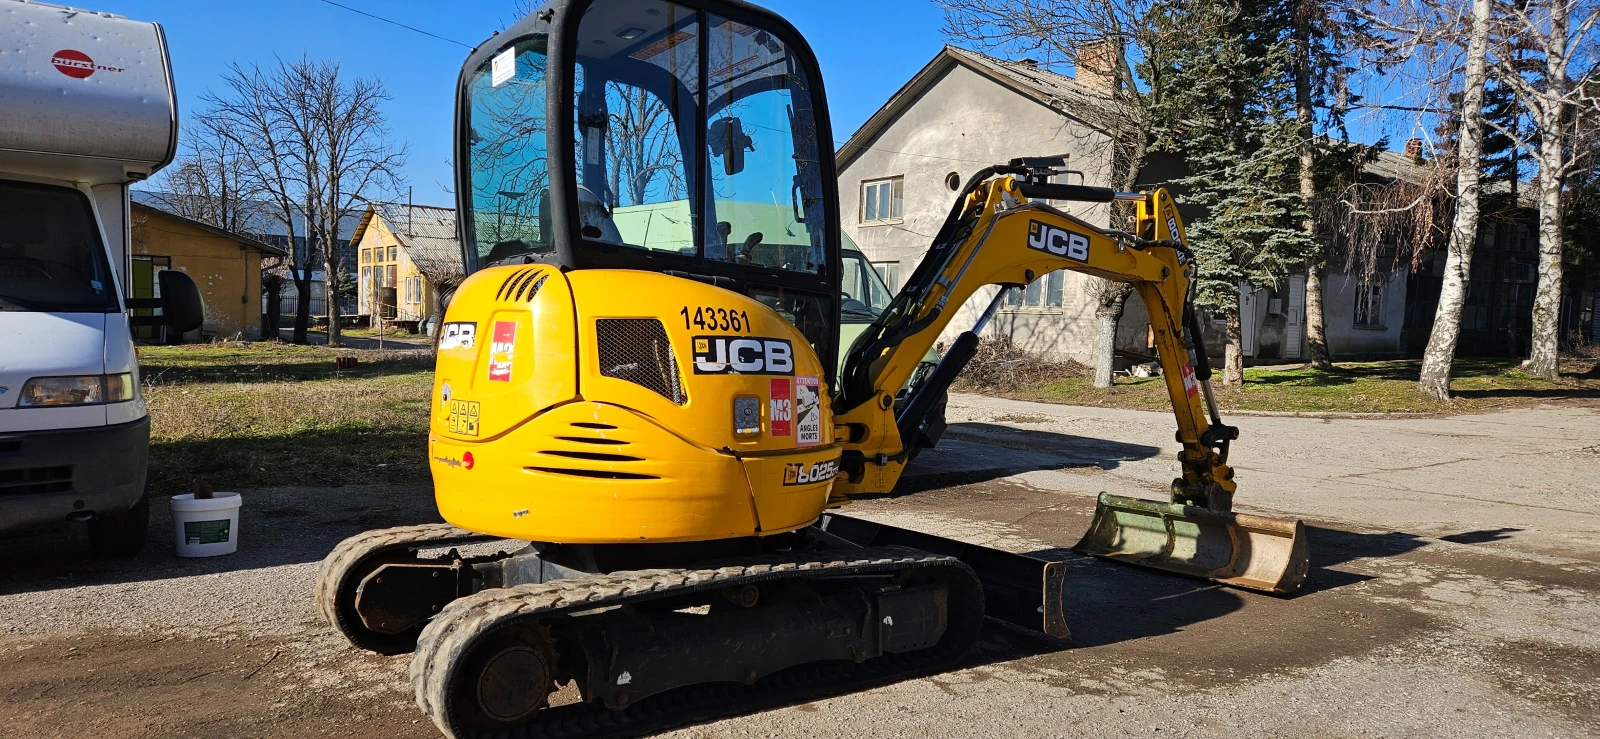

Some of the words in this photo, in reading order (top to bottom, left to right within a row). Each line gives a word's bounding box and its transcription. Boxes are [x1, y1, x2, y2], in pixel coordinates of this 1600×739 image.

[51, 58, 125, 72] bürstner
[1029, 225, 1089, 262] JCB
[680, 305, 751, 333] 143361
[695, 338, 793, 373] JCB
[796, 377, 819, 385] ATTENTION
[770, 398, 792, 421] M3
[799, 424, 819, 432] ANGLES
